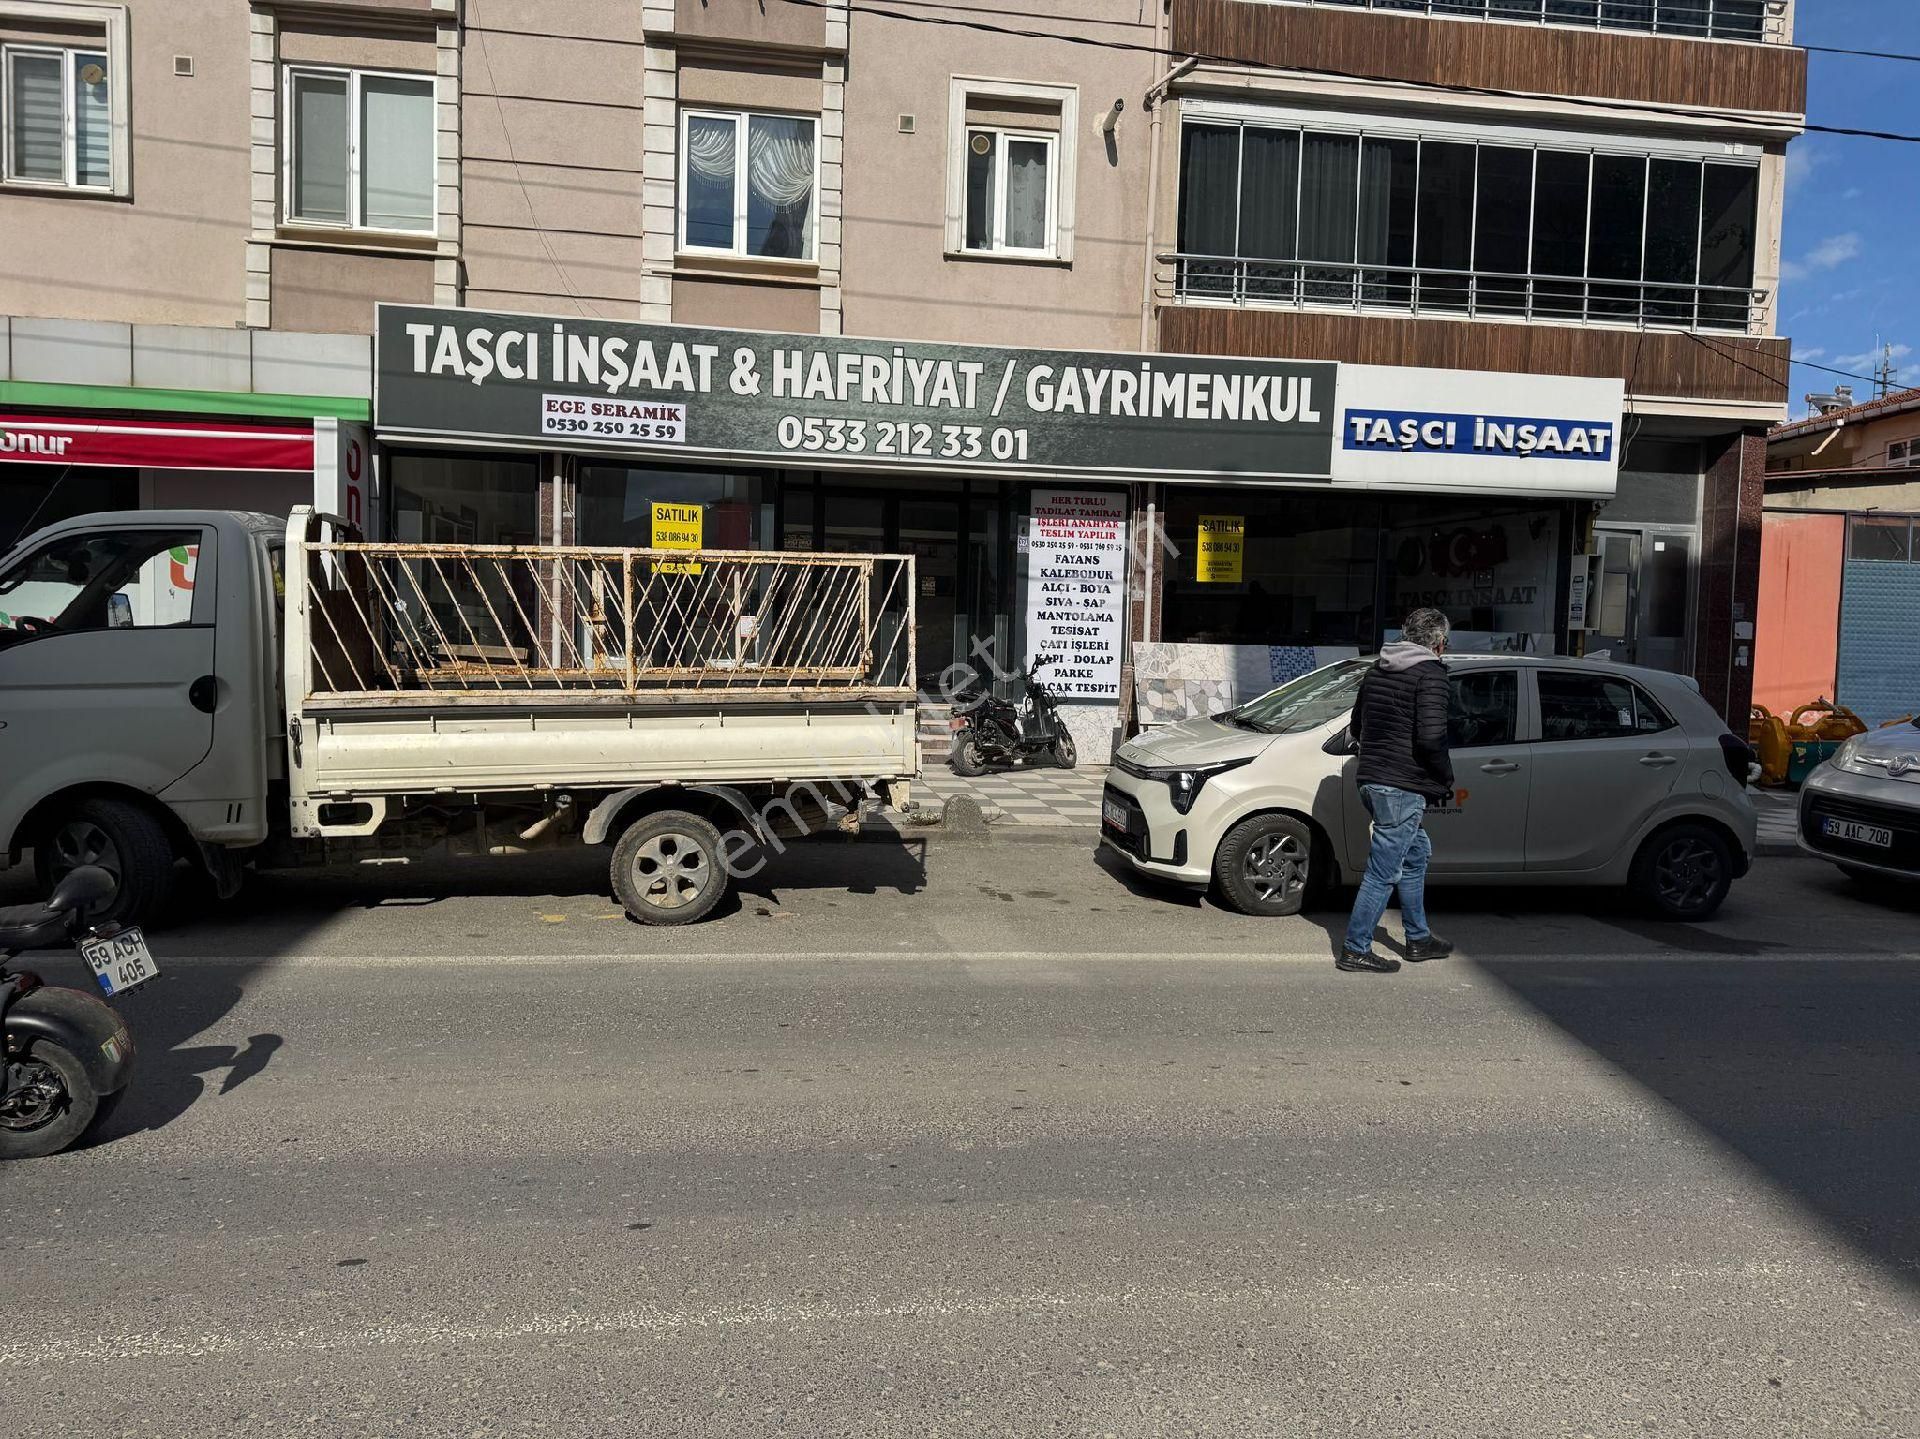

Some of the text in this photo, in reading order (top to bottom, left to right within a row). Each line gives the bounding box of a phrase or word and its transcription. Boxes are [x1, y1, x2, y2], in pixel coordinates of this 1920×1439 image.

[405, 322, 1321, 423] TAŞCI İNŞAAT & HAFRİYAT / GAYRİMENKUL
[546, 400, 682, 422] EGE SERAMİK
[546, 417, 677, 439] 0530 250 25 59
[777, 415, 1028, 461] 0533 212 33 01
[1350, 417, 1611, 459] TAŞCI İNŞAAT
[1051, 497, 1072, 505] HER
[656, 508, 699, 522] SATILIK
[1202, 520, 1240, 532] SATILIK
[1078, 531, 1116, 540] YAPILIR
[1055, 554, 1100, 565] FAYANS
[1041, 582, 1070, 594] ALÇI
[1080, 584, 1111, 594] BOYA
[1045, 597, 1072, 606] SIVA
[1083, 598, 1106, 609] ŞAP
[1037, 611, 1114, 622] MANTOLAMA
[1051, 624, 1100, 636] TESİSAT
[1040, 638, 1109, 652] ÇATI İŞLERİ
[1074, 655, 1114, 665] DOLAP
[1054, 668, 1094, 678] PARKE
[1075, 682, 1117, 693] TESPİT
[1828, 820, 1840, 834] 59
[1845, 823, 1864, 840] AAC
[88, 933, 146, 969] 59 ACH
[118, 958, 146, 985] 405
